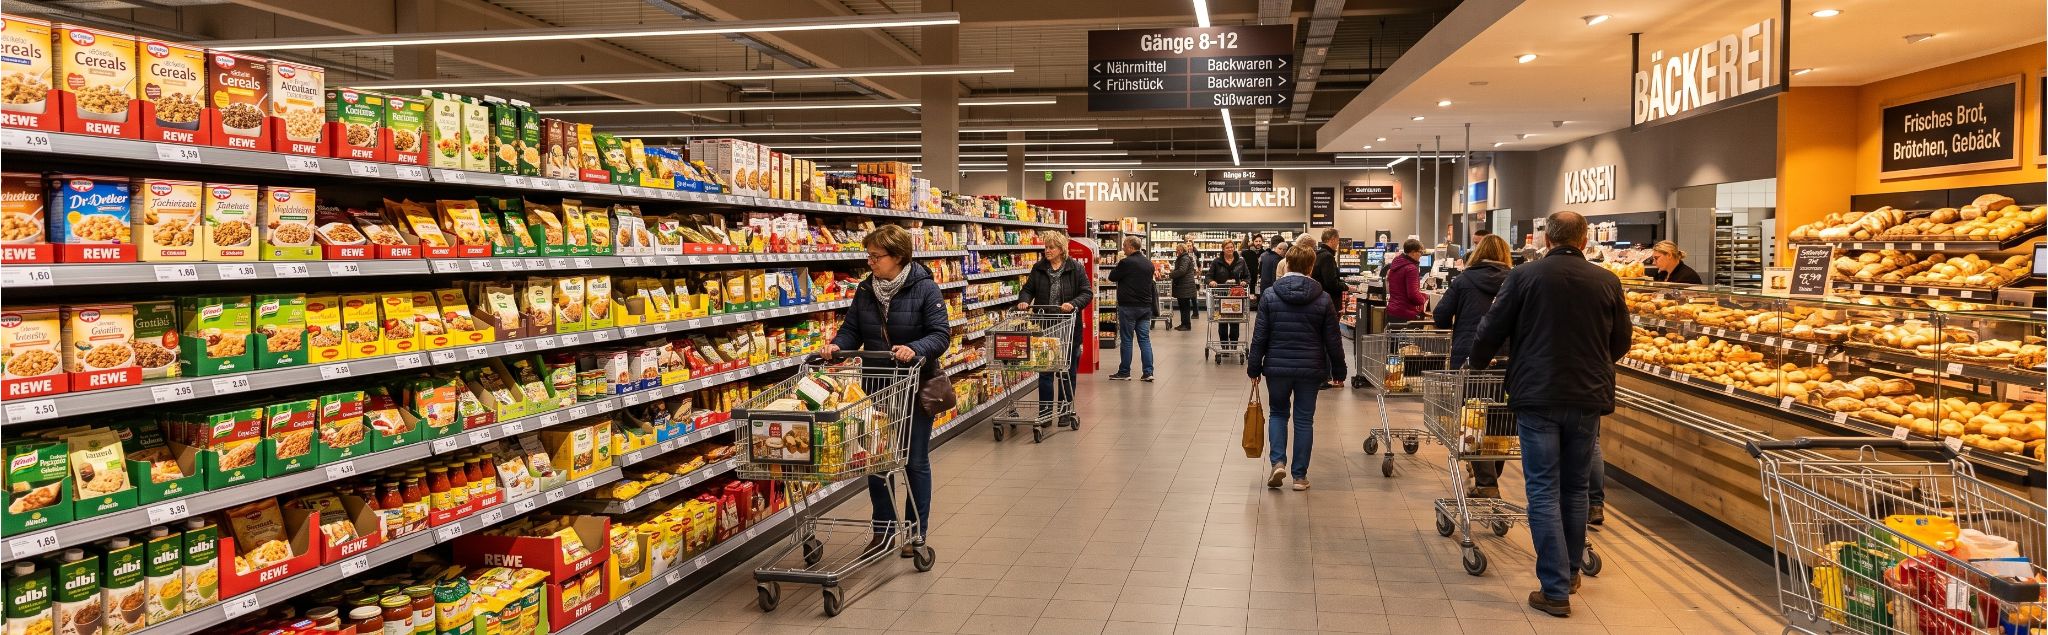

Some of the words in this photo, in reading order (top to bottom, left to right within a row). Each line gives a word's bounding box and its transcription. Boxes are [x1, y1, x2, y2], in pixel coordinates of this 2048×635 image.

[1141, 34, 1194, 54] Gänge
[1199, 32, 1238, 49] 8-12
[75, 51, 127, 71] Cereals
[1107, 61, 1167, 74] Nährmittel
[1207, 58, 1273, 71] Backwaren
[151, 63, 197, 81] Cereals
[1634, 18, 1775, 126] BÄCKEREI
[219, 73, 261, 90] Cereals
[1106, 77, 1164, 91] Frühstück
[1207, 76, 1273, 89] Backwaren
[1213, 93, 1272, 106] Süßwaren
[1, 113, 38, 127] REWE
[1904, 111, 1953, 133] Frisches
[1957, 103, 1987, 125] Brot,
[86, 122, 120, 135] REWE
[26, 135, 48, 147] 2,99
[163, 130, 194, 143] REWE
[229, 137, 256, 148] REWE
[292, 144, 316, 154] REWE
[1893, 138, 1948, 162] Brötchen,
[1952, 128, 2001, 153] Gebäck
[352, 148, 373, 158] REWE
[398, 153, 417, 163] REWE
[1062, 177, 1159, 202] GETRÄNKE
[1564, 165, 1616, 204] KASSEN
[83, 248, 120, 259] REWE
[341, 248, 364, 257] REWE
[391, 248, 412, 257] REWE
[90, 371, 127, 386] REWE
[10, 380, 52, 395] REWE
[36, 535, 56, 548] 1.69
[188, 539, 214, 554] albi
[341, 538, 368, 556] REWE
[153, 548, 179, 565] albi
[484, 553, 523, 568] REWE
[113, 559, 141, 577] albi
[575, 557, 592, 571] REWE
[259, 564, 288, 583] REWE
[65, 572, 96, 590] albi
[14, 586, 47, 605] albi
[575, 603, 592, 617] REWE
